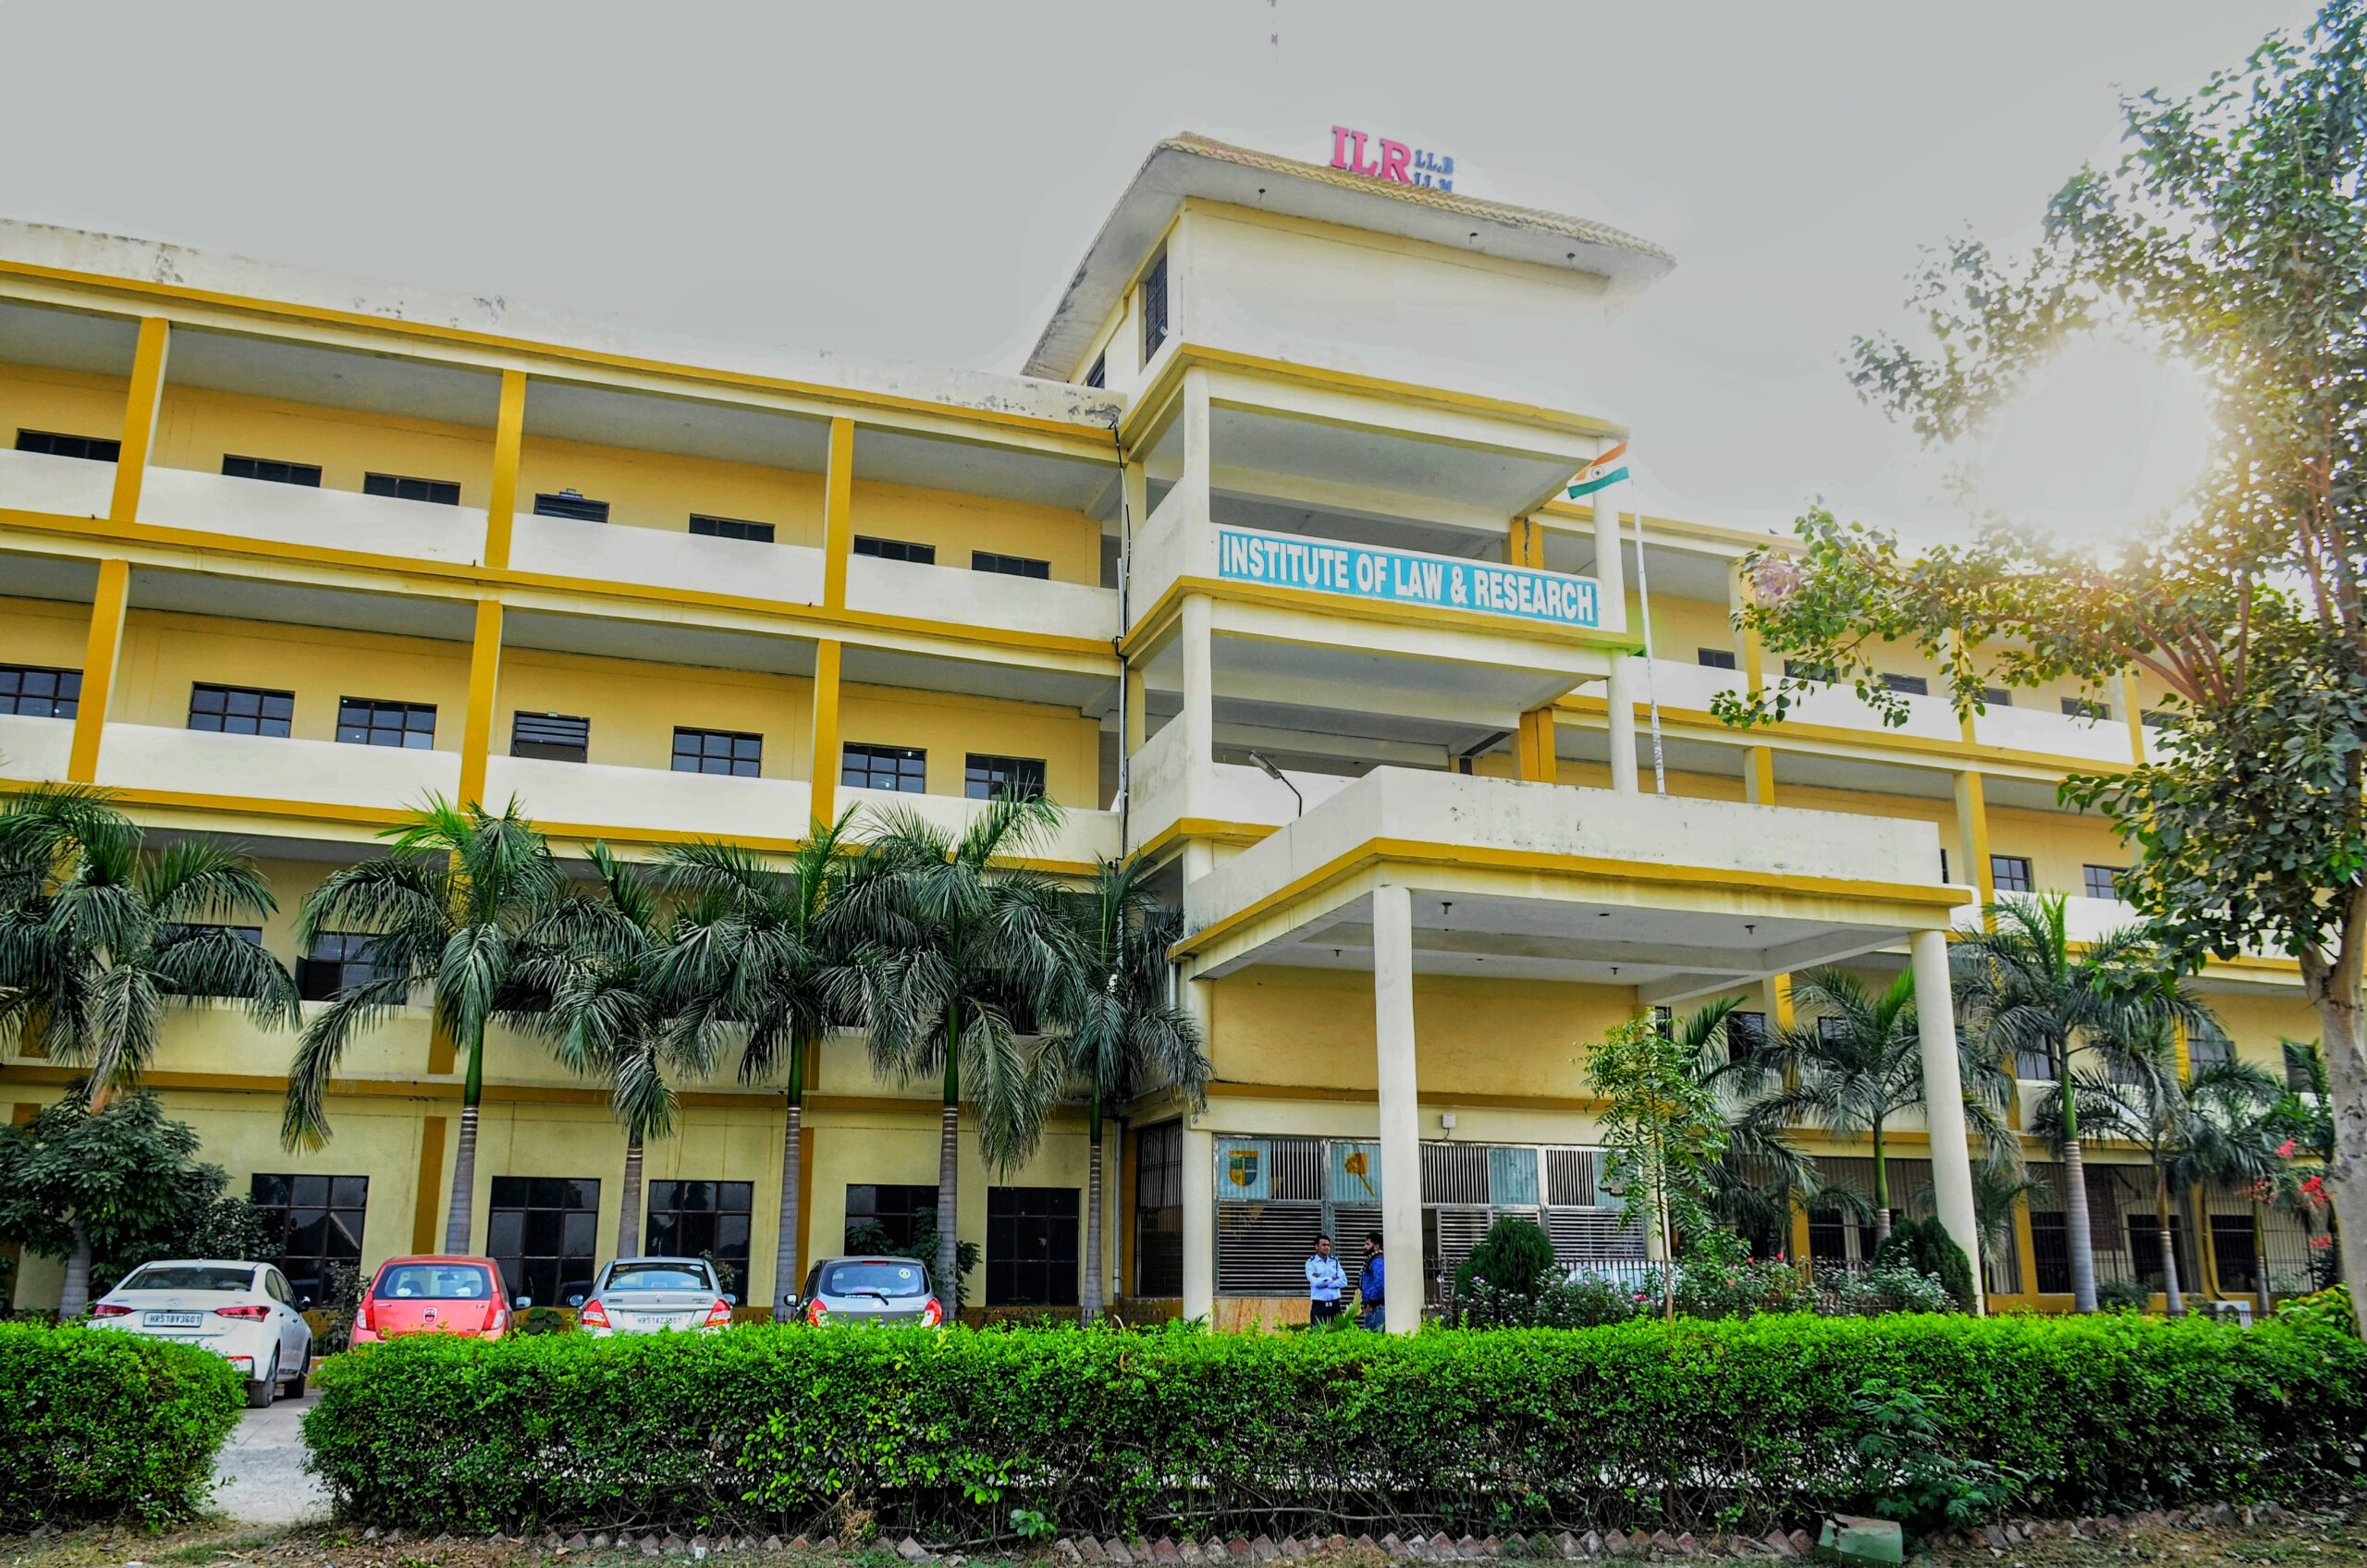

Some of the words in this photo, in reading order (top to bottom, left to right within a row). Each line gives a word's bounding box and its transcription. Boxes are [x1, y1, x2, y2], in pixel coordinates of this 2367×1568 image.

[1330, 126, 1413, 185] ILR
[1415, 149, 1453, 175] LL.B
[1222, 534, 1350, 589] INSTITUTE
[1355, 553, 1387, 593] OF
[1393, 557, 1442, 600] LAW
[1450, 566, 1468, 604] &
[1474, 569, 1593, 621] RESEARCH
